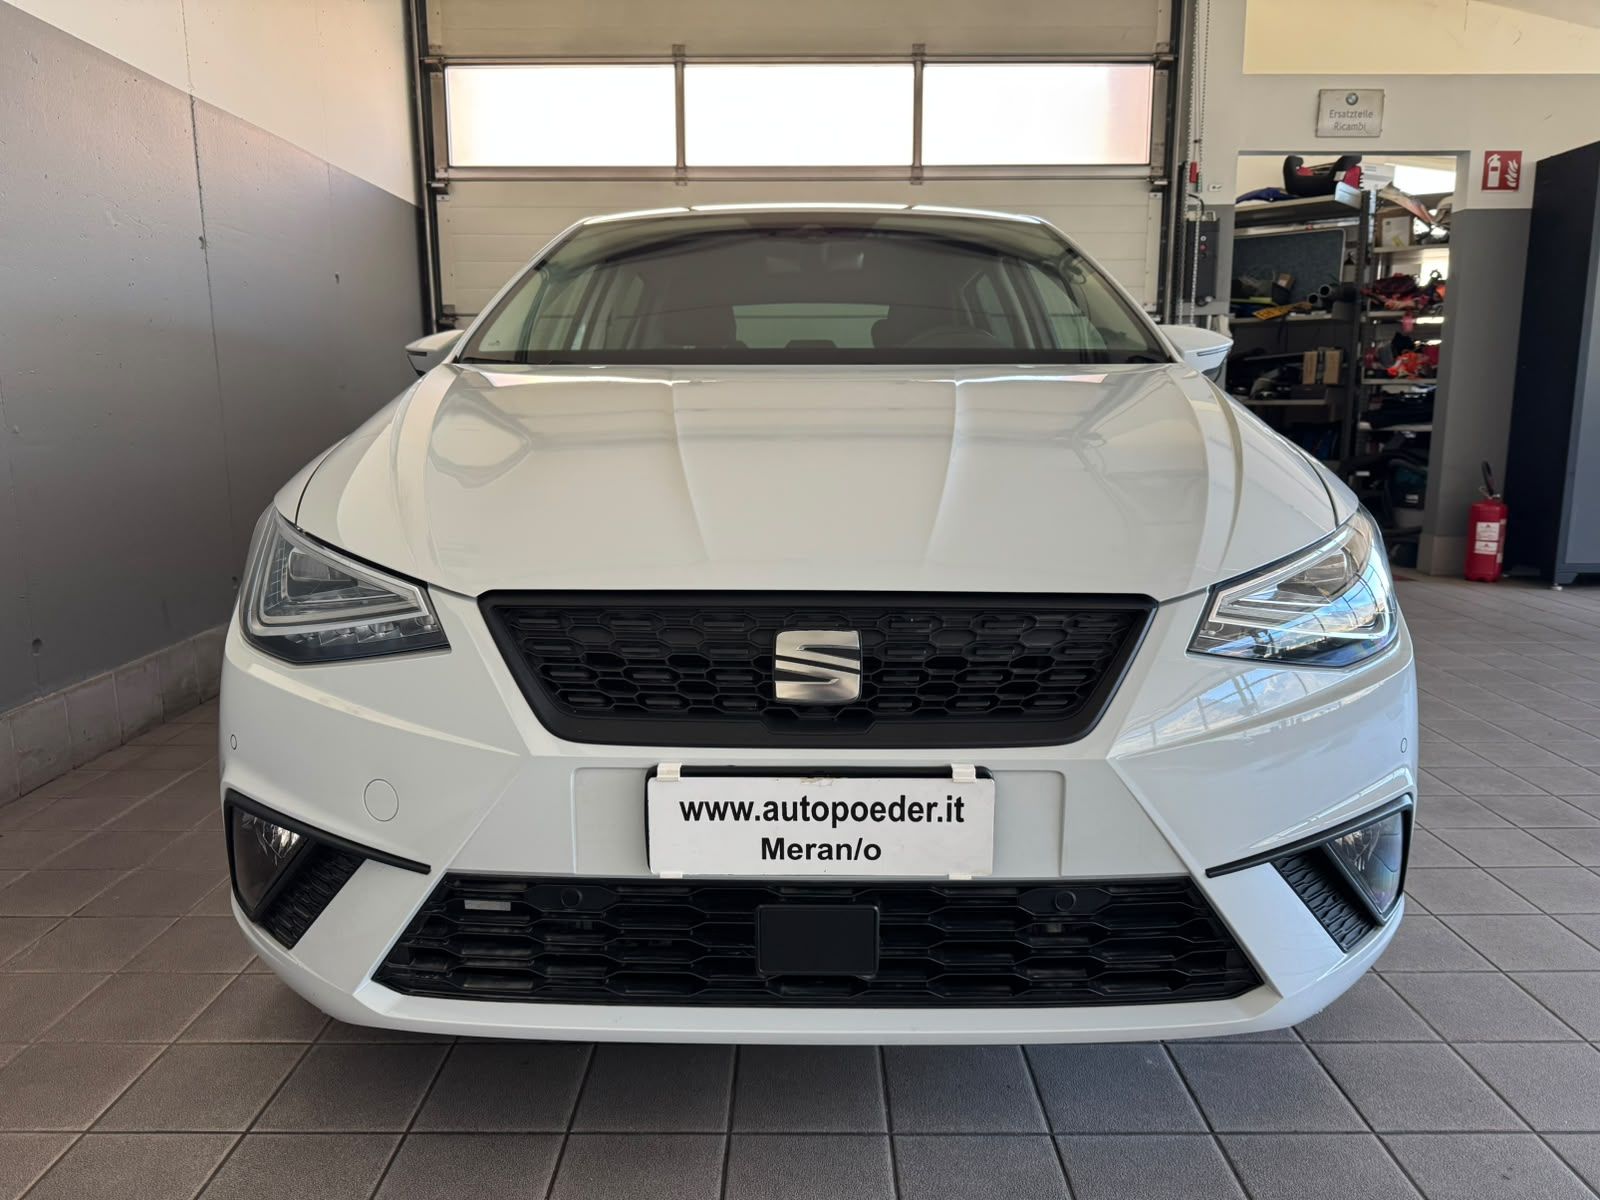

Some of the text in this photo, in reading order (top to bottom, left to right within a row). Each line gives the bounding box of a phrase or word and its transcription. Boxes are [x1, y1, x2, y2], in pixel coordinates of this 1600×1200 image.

[1329, 109, 1374, 119] Ersatzteile
[1333, 121, 1366, 131] Ricambi
[679, 794, 965, 829] www.autopoeder.it
[761, 837, 882, 861] Meran/o
